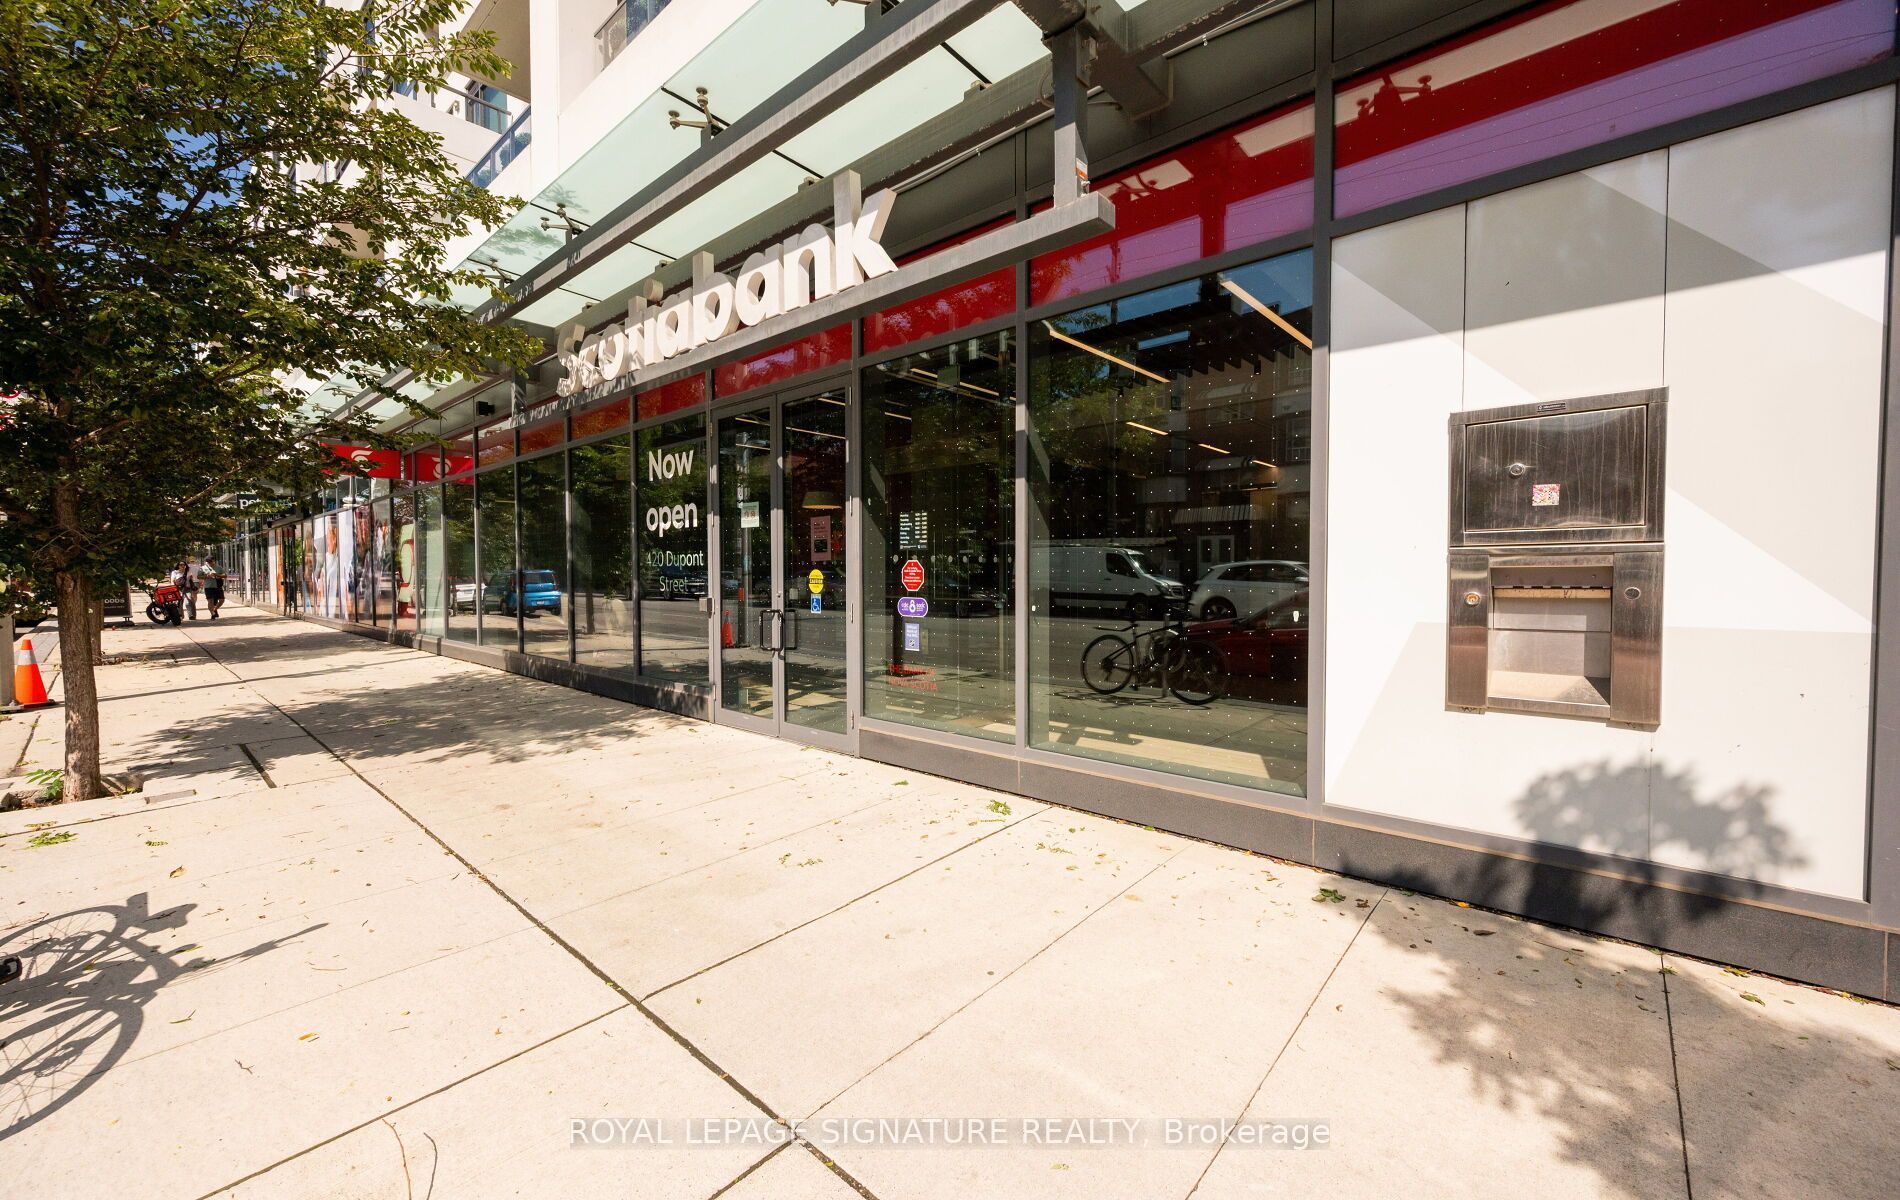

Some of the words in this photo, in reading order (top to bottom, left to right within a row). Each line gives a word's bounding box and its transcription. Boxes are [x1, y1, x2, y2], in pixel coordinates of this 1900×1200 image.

[556, 169, 898, 397] Scotiabank
[648, 449, 694, 481] Now
[646, 502, 698, 538] open
[646, 551, 664, 567] 420
[666, 550, 704, 570] Dupont
[659, 575, 689, 592] Street
